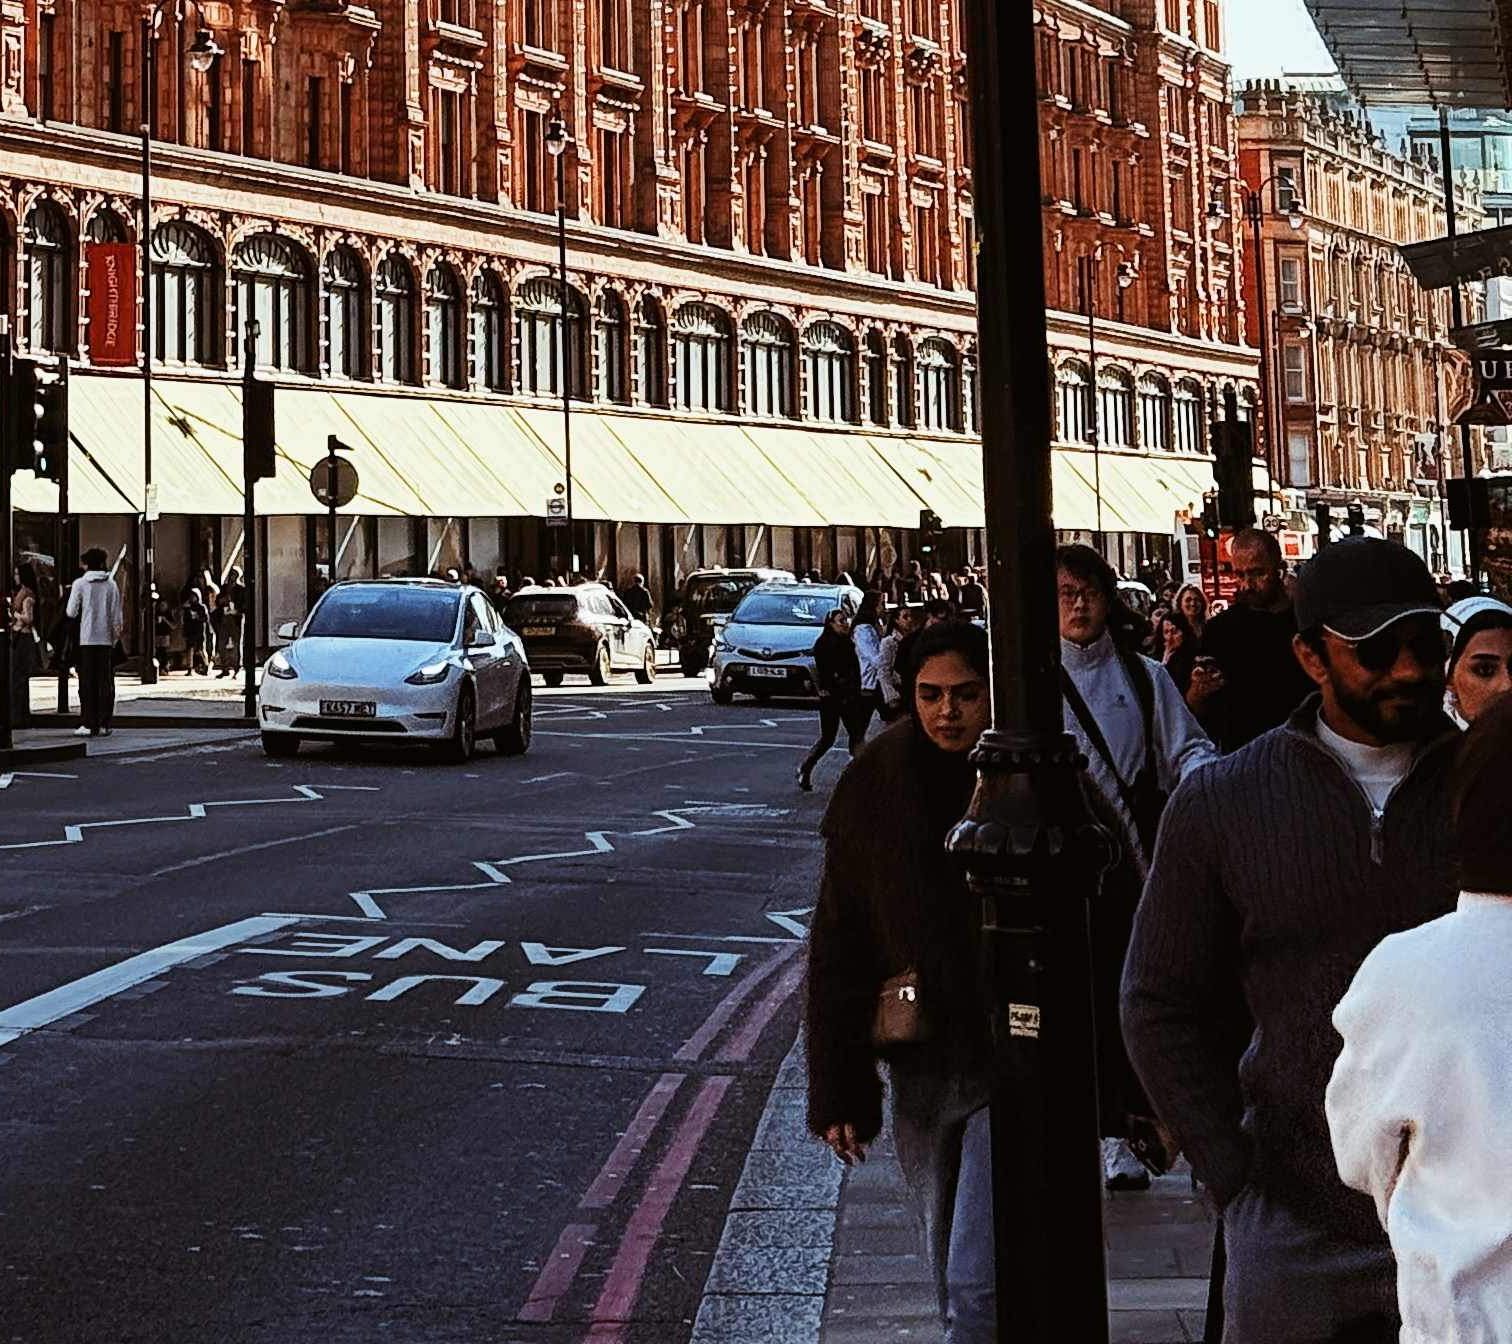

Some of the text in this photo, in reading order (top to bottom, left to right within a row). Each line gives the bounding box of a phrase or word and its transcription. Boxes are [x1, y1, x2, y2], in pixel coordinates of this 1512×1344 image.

[1265, 518, 1279, 528] 20
[237, 932, 747, 976] LANE
[231, 970, 647, 1014] BUS
